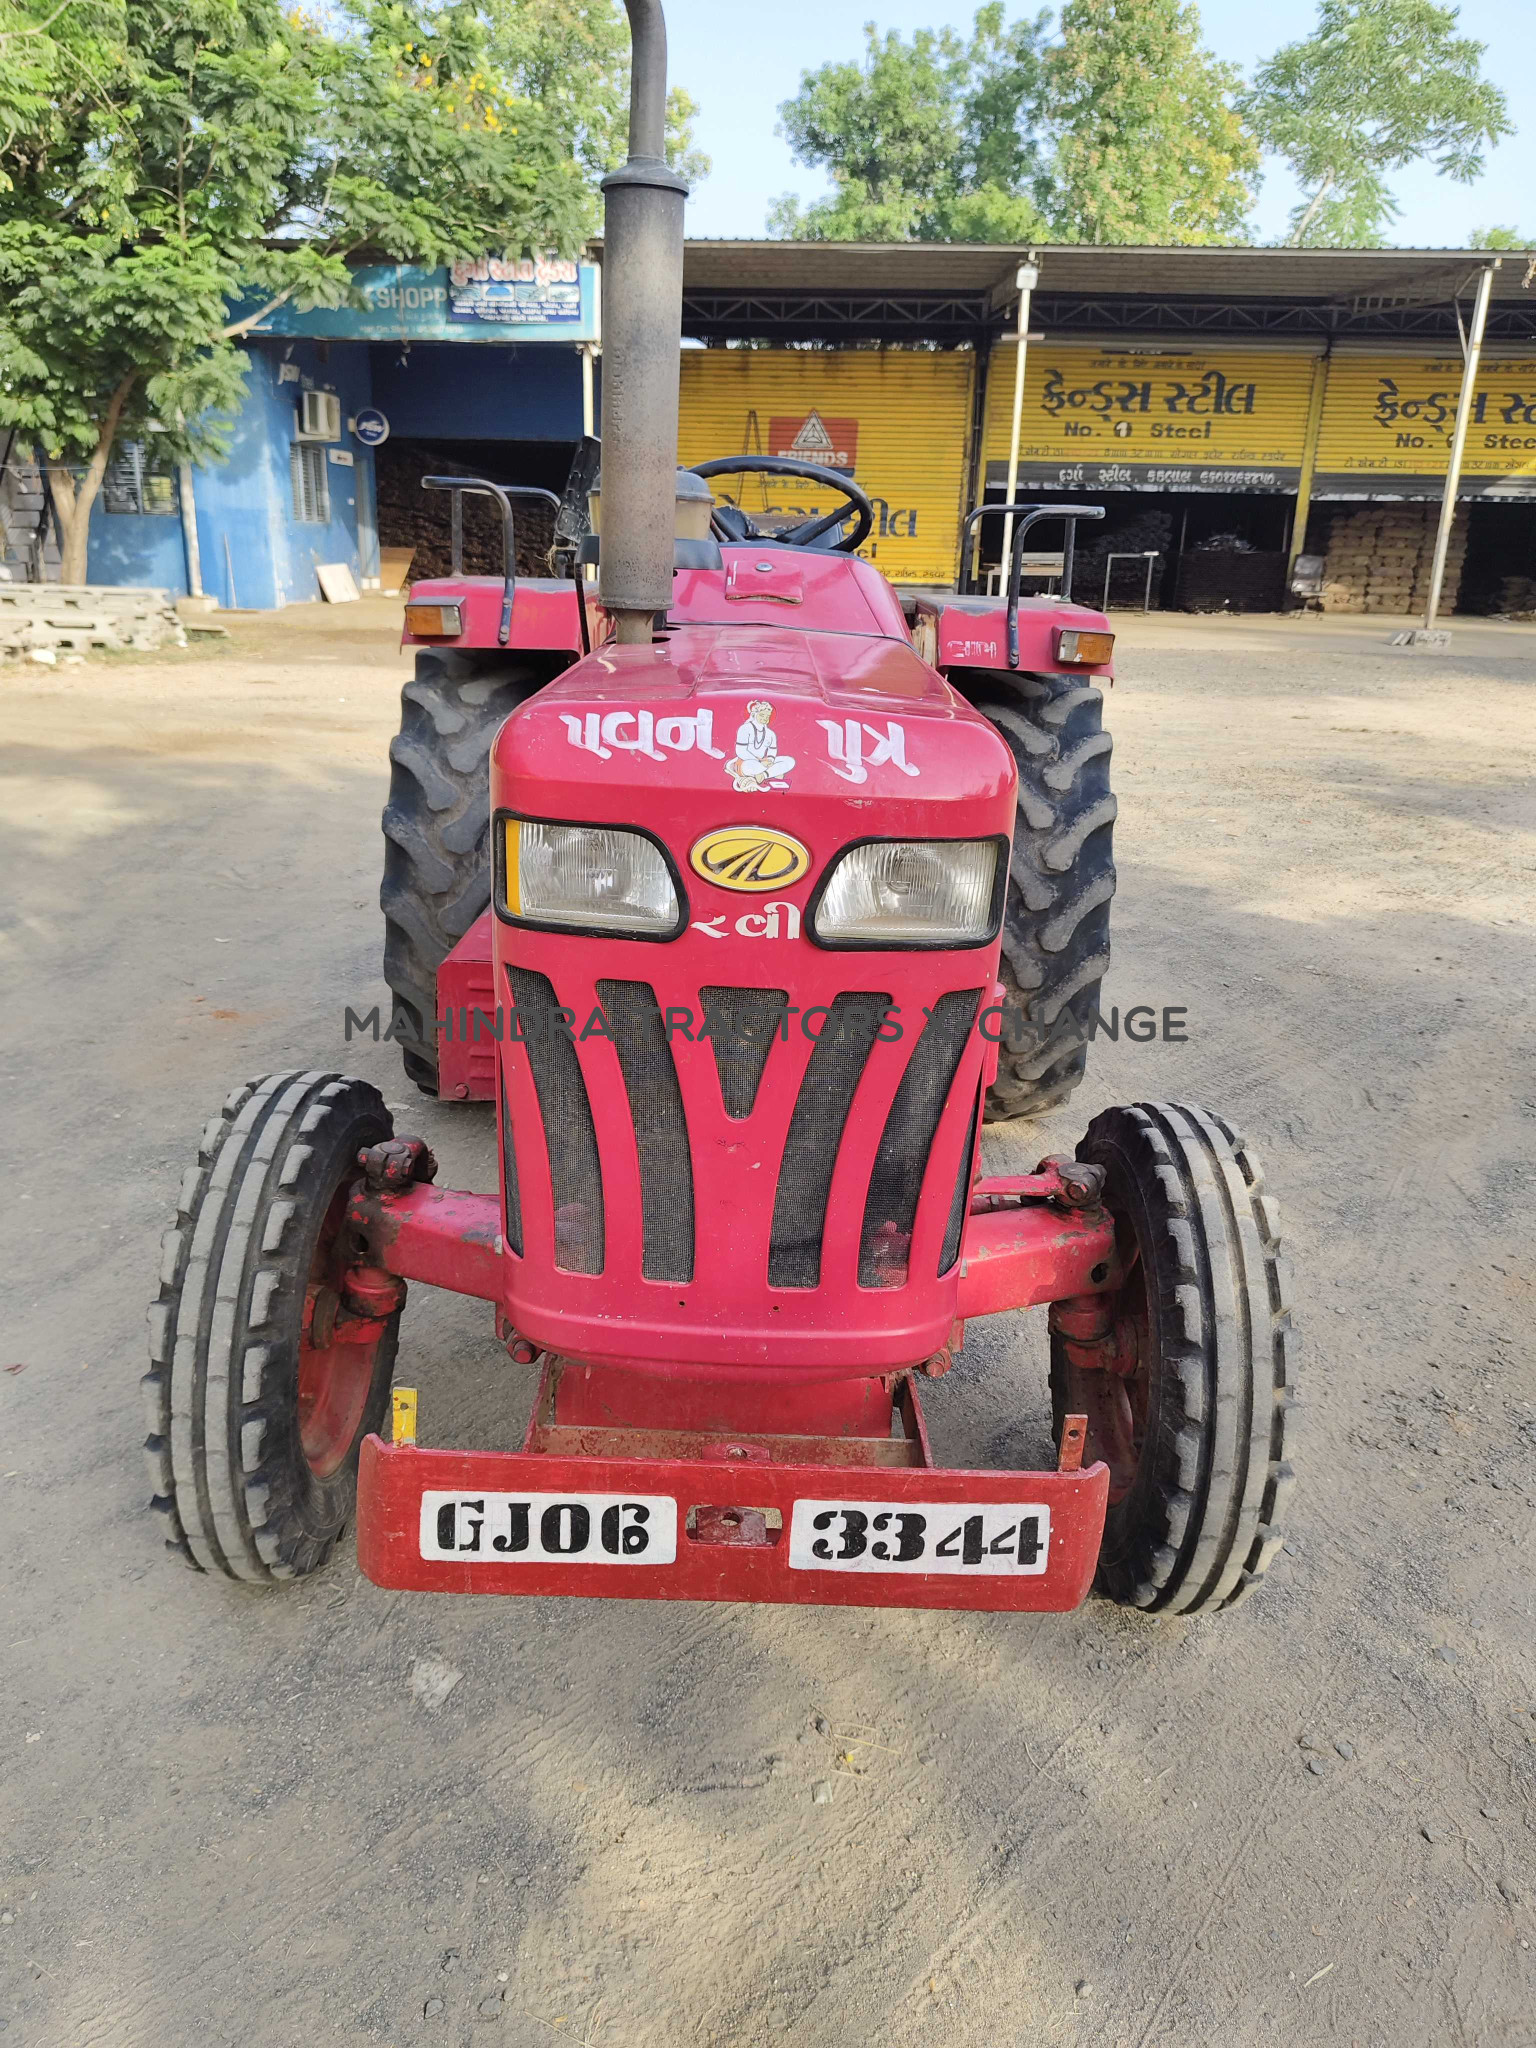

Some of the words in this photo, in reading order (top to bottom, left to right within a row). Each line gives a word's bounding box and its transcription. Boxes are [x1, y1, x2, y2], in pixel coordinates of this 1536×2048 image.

[376, 287, 448, 308] SHOPP
[1163, 370, 1256, 415] સ્ટીલ
[1064, 422, 1101, 438] No.
[1113, 421, 1132, 438] 1
[1151, 421, 1212, 439] Steel
[1395, 433, 1433, 448] No.
[1484, 434, 1536, 449] Stee
[690, 901, 800, 940] રવી
[437, 1499, 649, 1556] GJ06
[811, 1509, 1044, 1566] 3344
